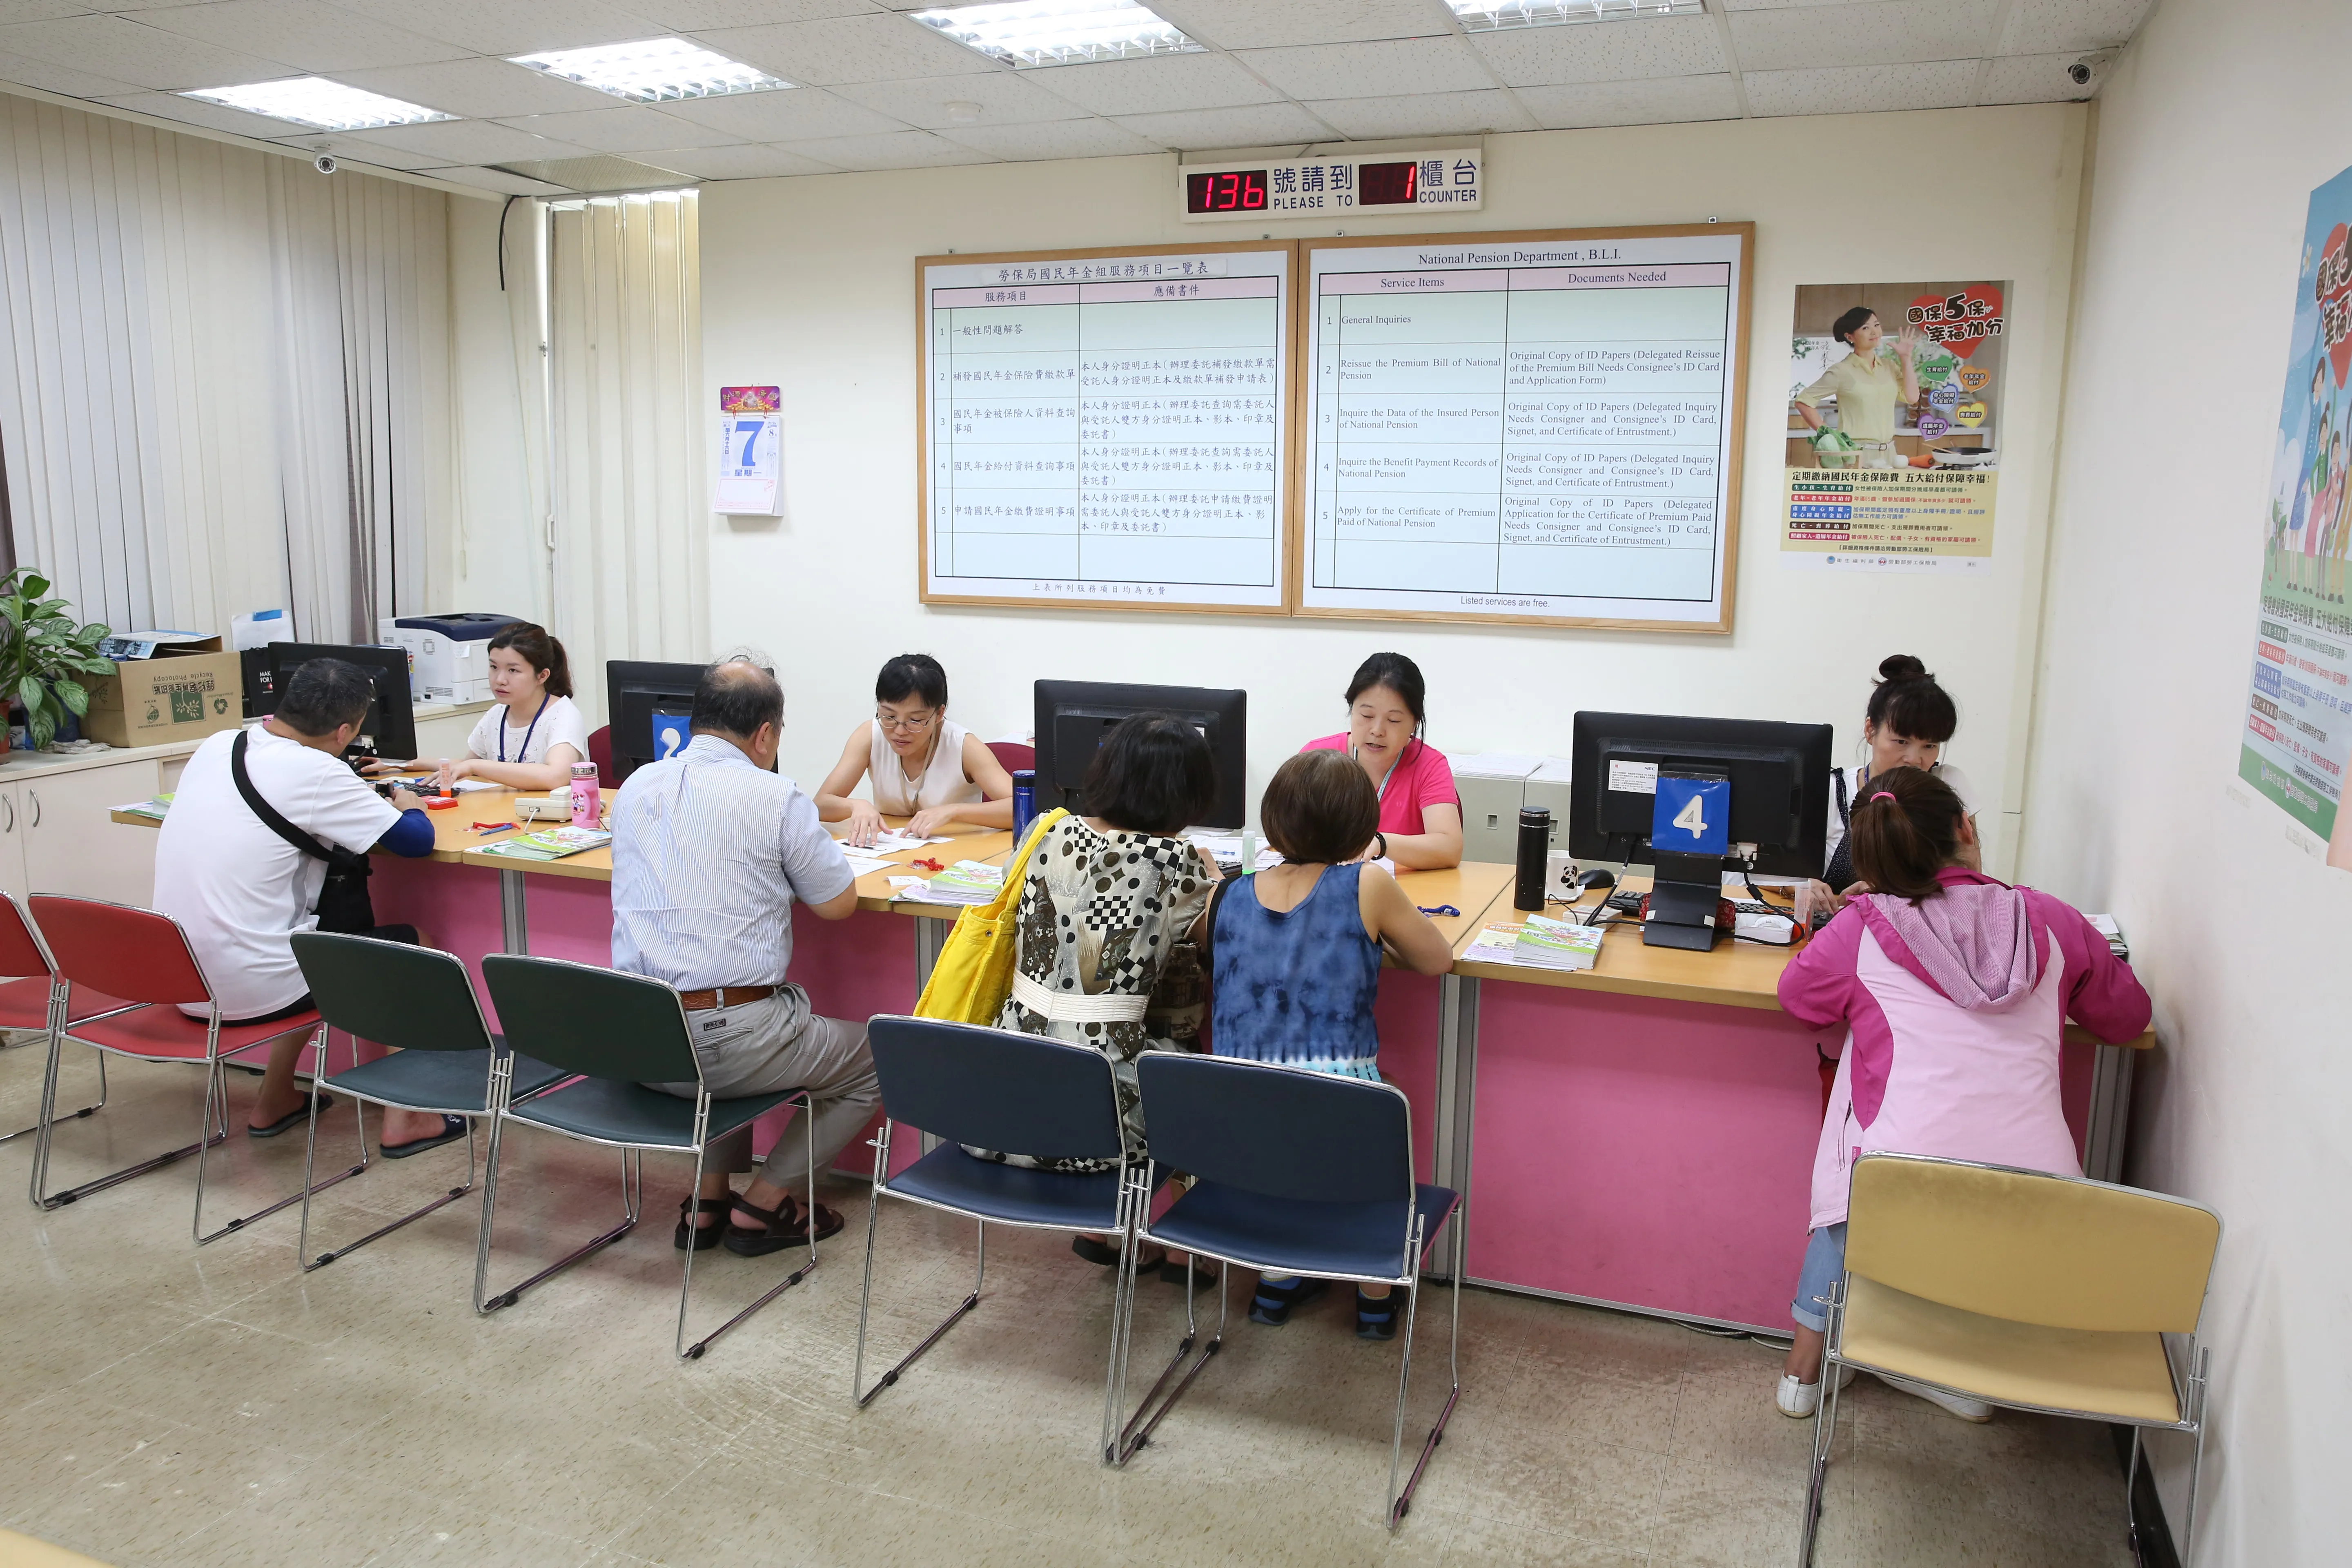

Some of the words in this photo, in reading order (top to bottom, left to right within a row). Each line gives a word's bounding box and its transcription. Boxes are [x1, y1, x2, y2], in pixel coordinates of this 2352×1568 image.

[1273, 163, 1353, 193] 號請到
[1419, 159, 1477, 188] 櫃台
[1406, 166, 1415, 199] 1
[1205, 174, 1264, 209] 136
[1419, 189, 1477, 203] COUNTER
[1274, 197, 1324, 210] PLEASE
[1336, 195, 1353, 207] TO
[1418, 253, 1463, 264] National
[1468, 253, 1509, 263] Pension
[1589, 249, 1621, 259] B.L.I.
[998, 261, 1209, 283] 勞保局國民年金組服務項目一覽表
[1568, 274, 1624, 283] Documents
[1628, 271, 1666, 281] Needed
[1381, 279, 1415, 287] Service
[1419, 278, 1444, 286] Items
[1153, 284, 1200, 297] 應備書件
[985, 290, 1027, 303] 服務項目
[1327, 316, 1332, 325] 1
[1342, 316, 1372, 324] General
[1376, 315, 1411, 325] Inquiries
[940, 327, 944, 336] 1
[953, 323, 1023, 336] 一般性問題解答
[1924, 318, 2004, 344] 幸福加分
[1510, 351, 1545, 361] Original
[1548, 351, 1571, 361] Copy
[1575, 351, 1585, 359] of
[1601, 351, 1630, 361] Papers
[1634, 350, 1682, 361] (Delegated
[1686, 350, 1720, 358] Reissue
[1452, 358, 1462, 366] of
[1537, 363, 1575, 372] Premium
[1597, 363, 1624, 371] Needs
[1683, 363, 1695, 371] ID
[1698, 363, 1719, 371] Card
[940, 372, 945, 381] 2
[952, 369, 1076, 382] 補發國民年金保險費繳款單
[1526, 376, 1576, 386] Application
[1579, 376, 1606, 385] Form)
[1340, 409, 1368, 418] Inquire
[1410, 408, 1419, 416] of
[1421, 408, 1433, 416] the
[1437, 408, 1467, 416] Insured
[1508, 403, 1543, 412] Original
[1547, 403, 1570, 412] Copy
[1573, 402, 1584, 410] of
[1601, 403, 1629, 412] Papers
[1633, 402, 1681, 413] (Delegated
[1685, 403, 1717, 413] Inquiry
[953, 408, 1075, 419] 國民年金被保險人資料查詢
[1325, 414, 1330, 423] 3
[940, 418, 945, 426] 3
[953, 423, 972, 434] 事項
[1508, 427, 1537, 437] Signet,
[1605, 427, 1615, 435] of
[1617, 428, 1676, 437] Entrustment.)
[1080, 429, 1116, 440] 委託書）
[735, 421, 765, 466] 7
[953, 461, 1075, 472] 國民年金給付資料查詢事項
[1339, 458, 1367, 467] Inquire
[1416, 459, 1450, 468] Payment
[1080, 475, 1116, 486] 委託書）
[1792, 471, 1899, 483] 定期繳納國民年金保險費
[954, 505, 1075, 517] 申請國民年金繳費證明事項
[1338, 506, 1362, 516] Apply
[1399, 507, 1441, 515] Certificate
[1404, 519, 1435, 527] Pension
[1032, 583, 1165, 595] 上表所列服務項目均為免費
[1461, 596, 1483, 606] Listed
[1485, 597, 1517, 607] services
[1533, 598, 1550, 608] free.
[154, 674, 187, 682] Photocopy
[1673, 795, 1708, 839] 4
